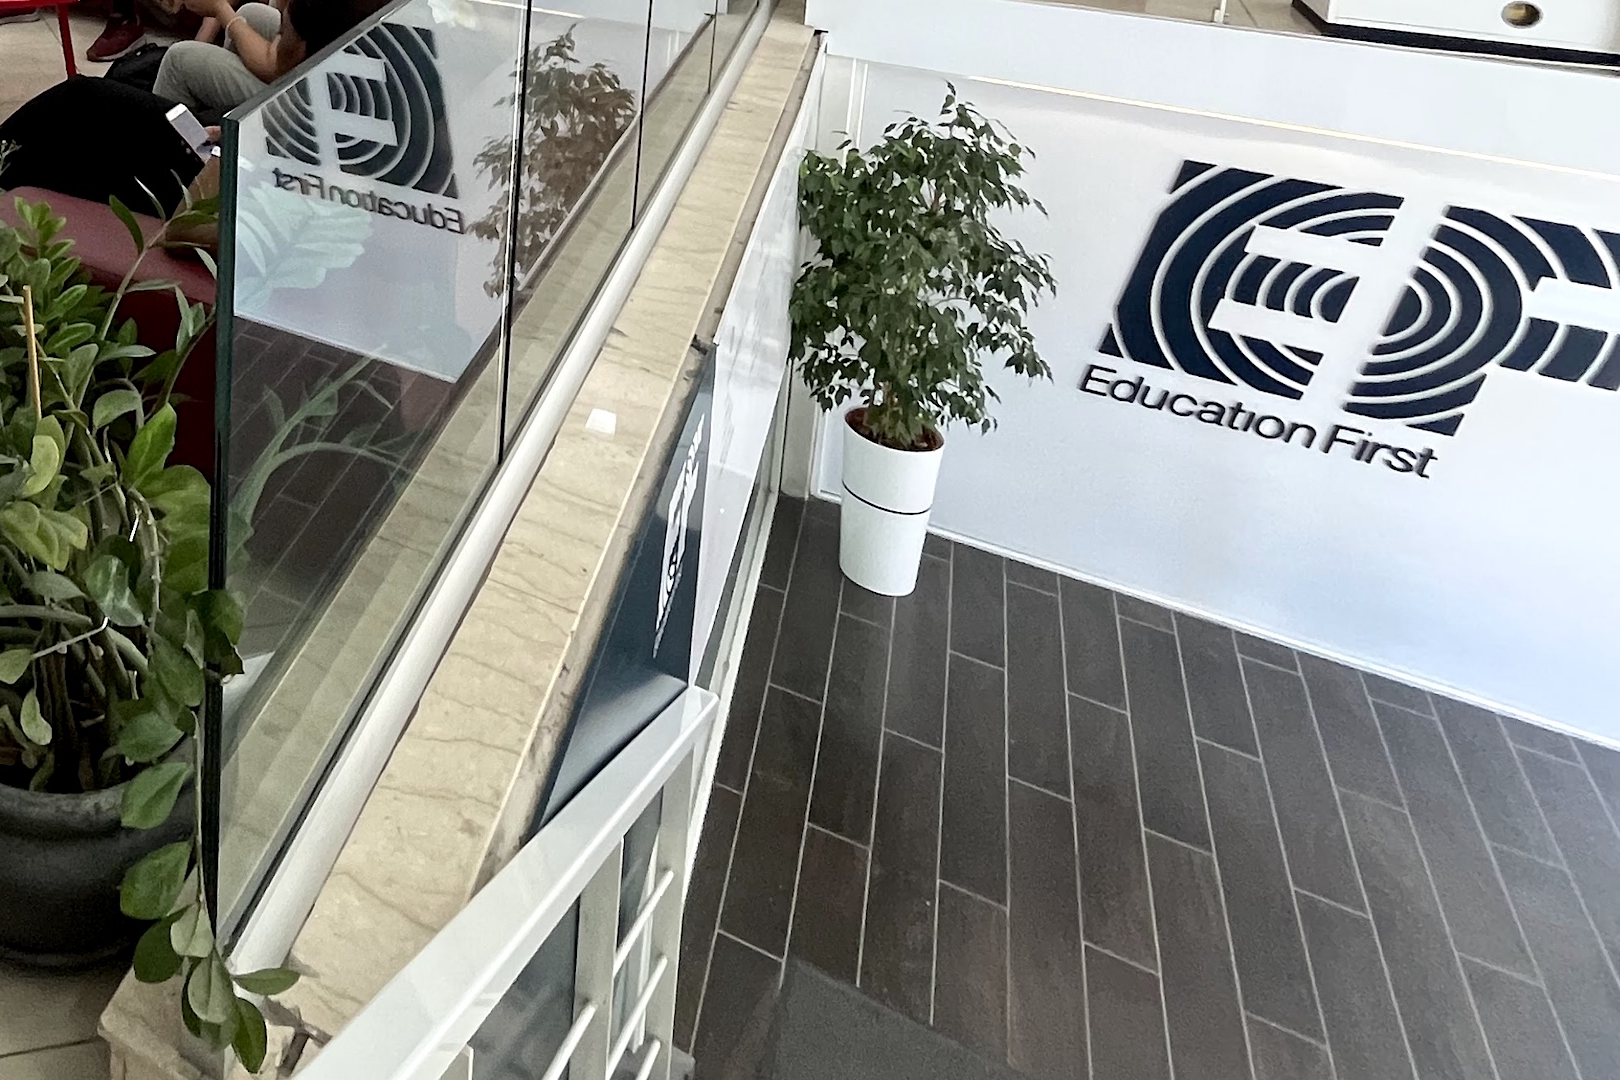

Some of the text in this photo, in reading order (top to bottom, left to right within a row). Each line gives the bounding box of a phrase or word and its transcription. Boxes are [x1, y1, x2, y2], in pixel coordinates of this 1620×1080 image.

[1096, 159, 1620, 437] EF
[1079, 363, 1440, 479] Education First
